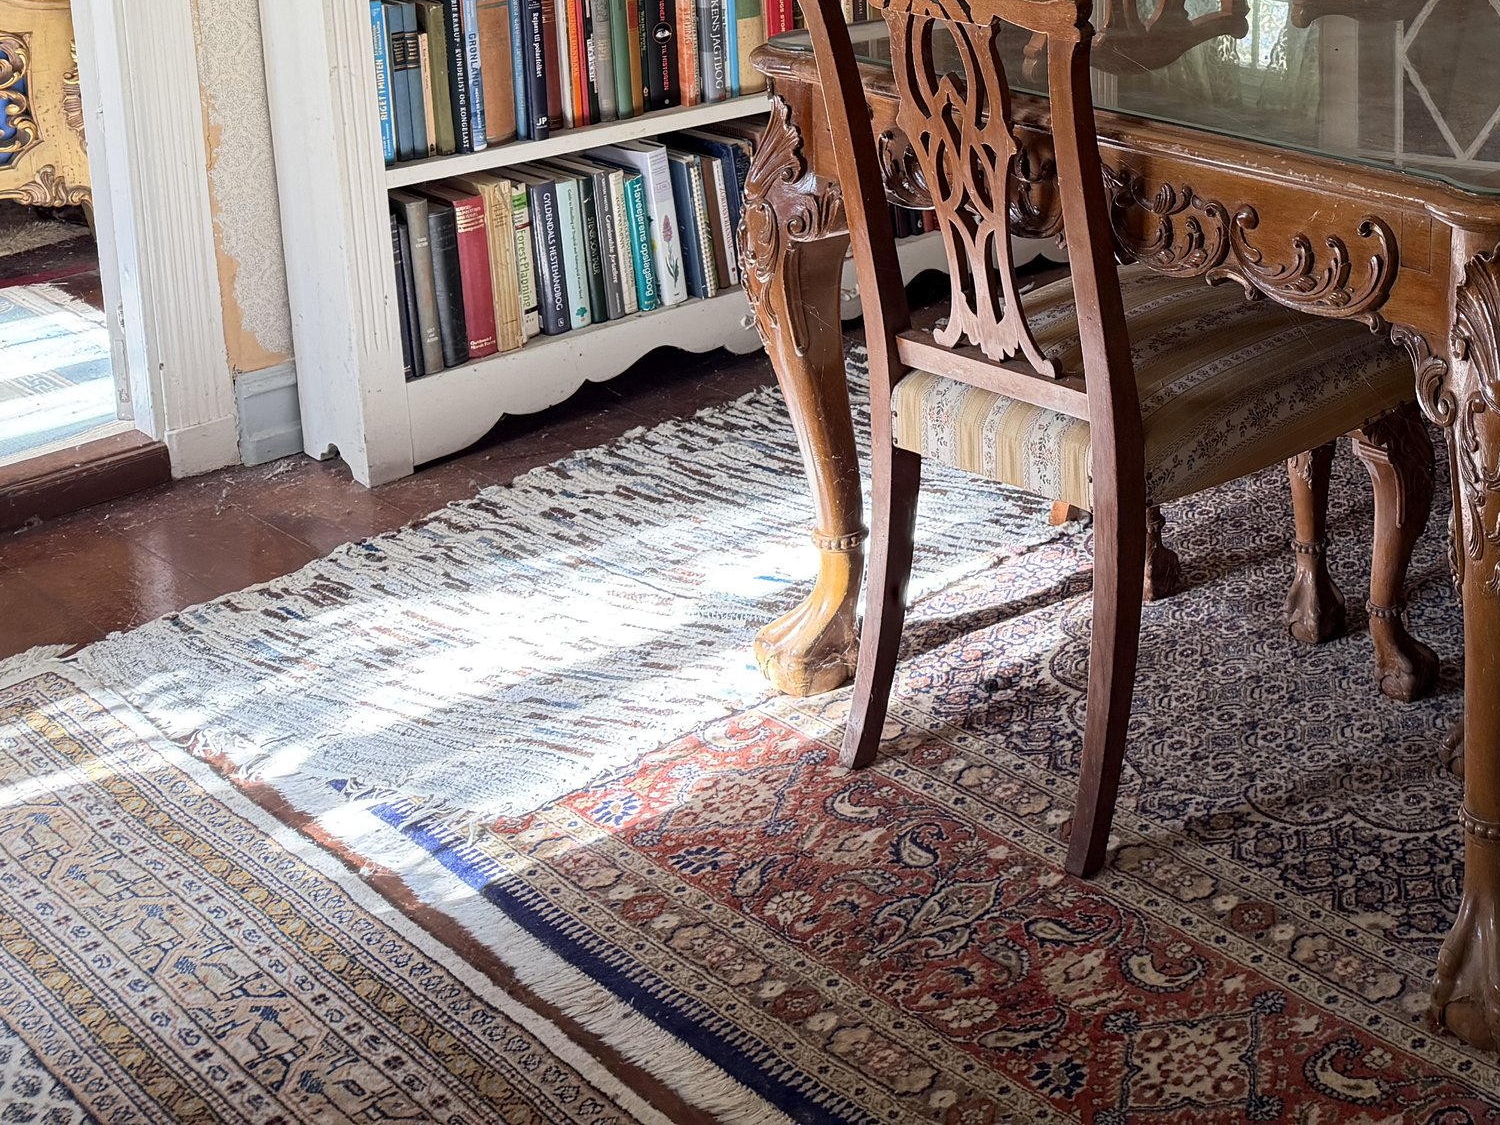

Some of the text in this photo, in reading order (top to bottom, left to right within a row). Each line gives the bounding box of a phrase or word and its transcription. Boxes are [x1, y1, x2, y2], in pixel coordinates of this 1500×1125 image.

[531, 12, 539, 33] Rejsen
[375, 59, 385, 83] MIDTEN
[455, 49, 465, 92] KVINDELIST
[468, 34, 479, 87] GRØNLAND
[533, 43, 542, 77] polarfolket
[710, 33, 724, 89] JAGTBOG
[379, 91, 387, 121] RIGET
[459, 94, 466, 105] OG
[460, 107, 469, 148] KONGELAST
[536, 117, 547, 126] JP
[517, 230, 532, 308] Forest Planning
[543, 193, 563, 311] GYLDENDALS HESTEHÅNDBOG
[641, 242, 654, 297] opslagsbog
